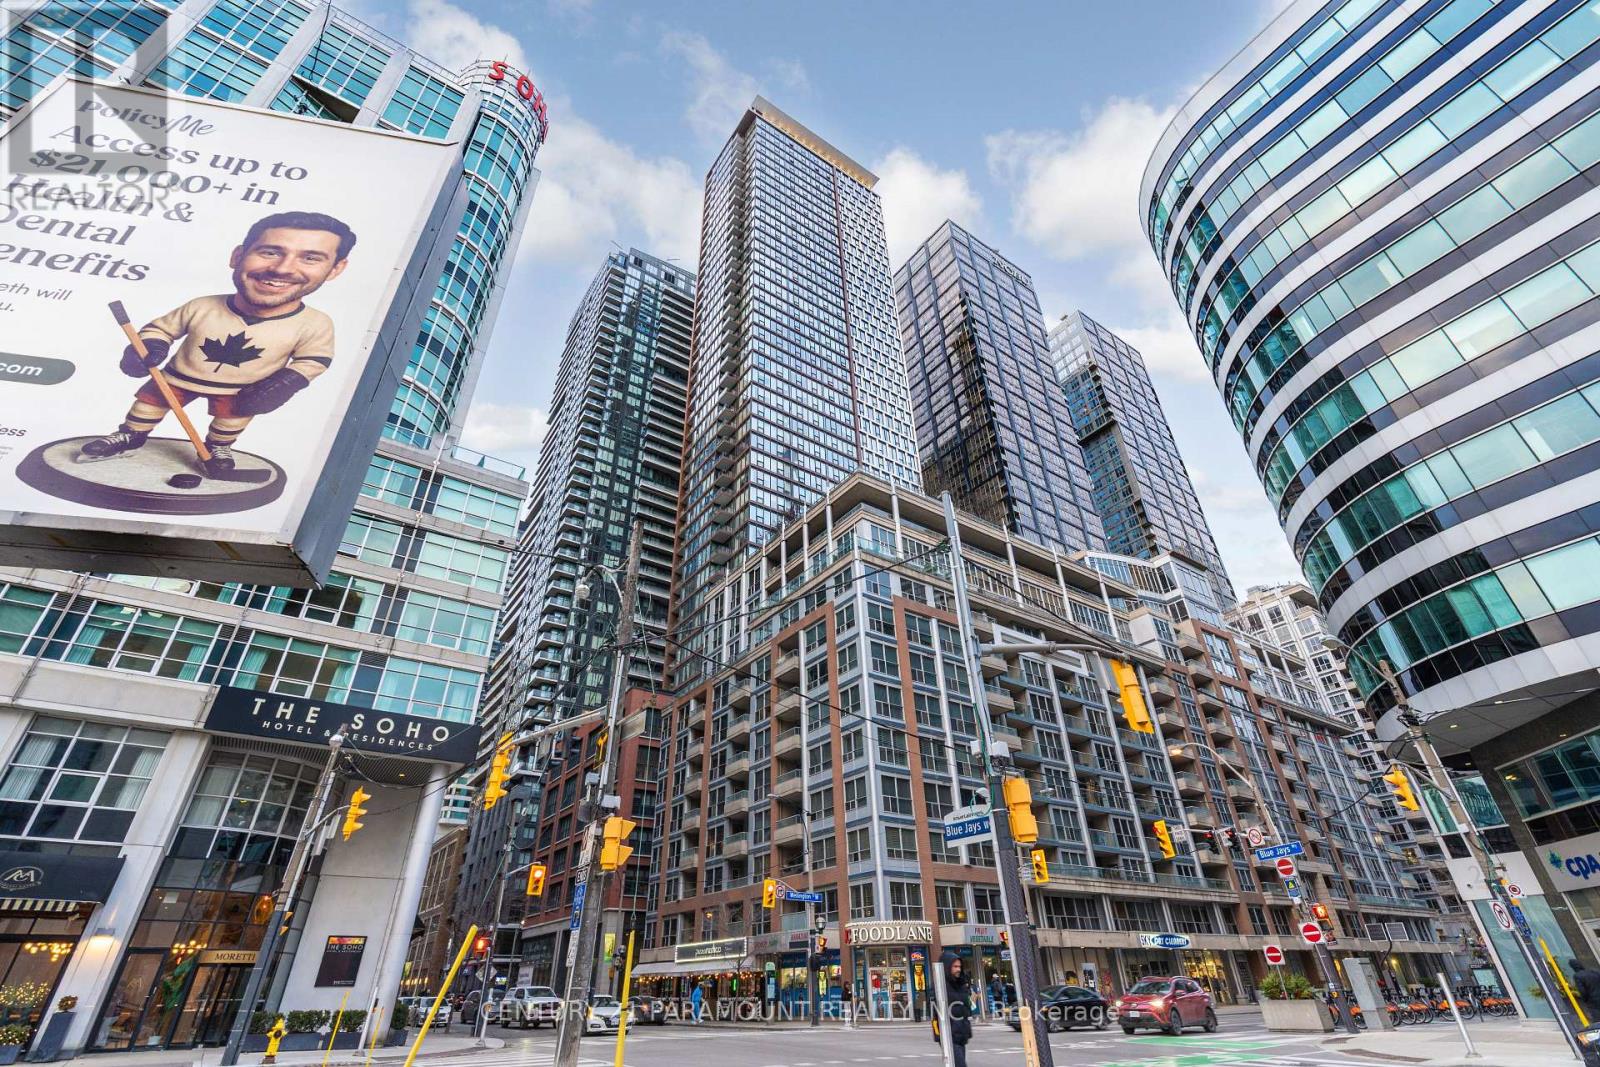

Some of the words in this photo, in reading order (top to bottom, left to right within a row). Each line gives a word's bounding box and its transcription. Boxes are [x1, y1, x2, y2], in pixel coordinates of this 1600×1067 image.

[51, 125, 200, 164] Access
[209, 154, 260, 176] up
[272, 161, 308, 181] to
[28, 148, 232, 195] $21,000+
[241, 182, 281, 205] in
[2, 173, 153, 217] Health
[163, 202, 194, 222] &
[37, 287, 72, 301] will
[252, 698, 320, 724] THE
[351, 713, 449, 742] SOHO
[262, 720, 312, 735] HOTEL
[946, 824, 963, 837] Blue
[965, 822, 982, 834] Jays
[1259, 849, 1274, 859] Blue
[1276, 846, 1291, 858] Jays
[852, 926, 933, 943] FOODLANE
[214, 953, 257, 962] MORETTI
